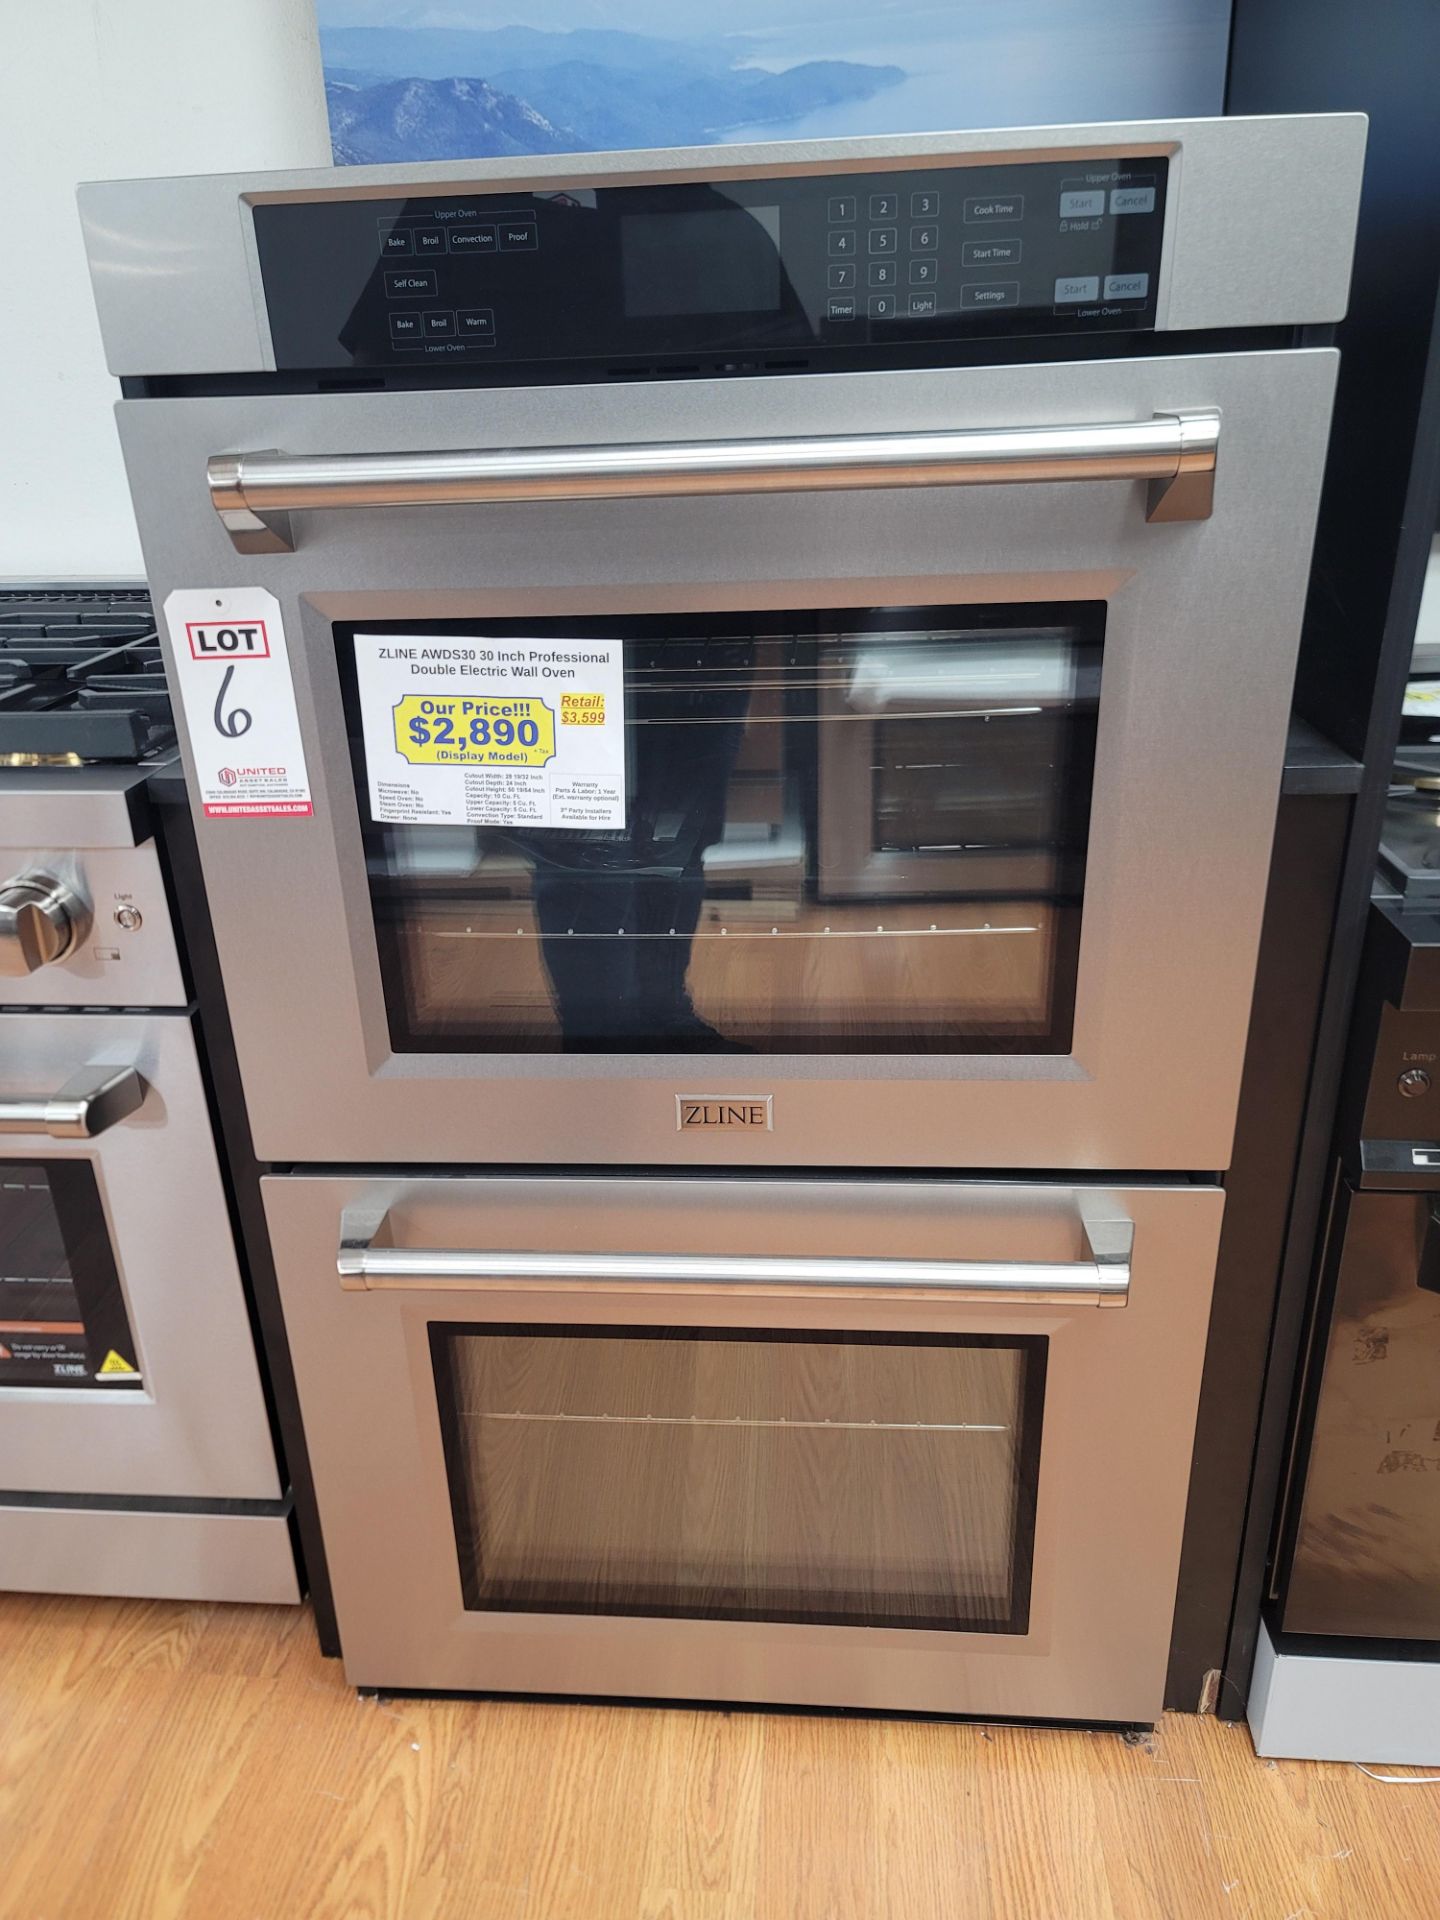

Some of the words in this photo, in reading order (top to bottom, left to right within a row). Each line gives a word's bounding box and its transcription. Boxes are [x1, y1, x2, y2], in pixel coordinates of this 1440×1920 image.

[1086, 174, 1110, 184] Upper
[1111, 173, 1132, 181] Oven
[922, 198, 929, 212] 3
[1070, 198, 1092, 208] Start
[1115, 195, 1148, 206] Cancel
[840, 204, 845, 217] 1
[880, 201, 887, 214] 2
[974, 204, 994, 214] Cook
[995, 204, 1014, 214] Time
[434, 210, 456, 220] Upper
[458, 209, 477, 217] Oven
[1070, 222, 1089, 231] Hold
[388, 238, 405, 246] Bake
[422, 236, 439, 245] Broil
[452, 234, 493, 244] Convection
[508, 232, 528, 241] Proof
[880, 234, 887, 247] 5
[921, 232, 928, 244] 6
[838, 237, 846, 249] 4
[973, 248, 992, 258] Start
[992, 248, 1011, 257] Time
[838, 271, 846, 283] 7
[879, 269, 886, 281] 8
[920, 266, 927, 279] 9
[394, 279, 407, 288] Self
[408, 279, 428, 287] Clean
[1109, 281, 1141, 292] Cancel
[1064, 284, 1087, 295] Start
[975, 290, 1005, 302] Settings
[831, 305, 853, 314] Timer
[878, 301, 885, 313] 0
[912, 300, 933, 311] Light
[1078, 308, 1100, 317] Lower
[1102, 308, 1122, 316] Oven
[397, 320, 413, 328] Bake
[431, 319, 447, 327] Broil
[466, 318, 487, 326] Warm
[425, 344, 446, 352] Lower
[447, 344, 466, 352] Oven
[197, 629, 257, 652] LOT
[378, 648, 418, 659] ZLINE
[421, 649, 476, 660] AWDS30
[480, 650, 494, 661] 30
[498, 650, 525, 662] Inch
[529, 651, 609, 663] Professional
[411, 664, 456, 675] Double
[460, 664, 507, 677] Electric
[511, 666, 538, 677] Wall
[542, 667, 575, 678] Oven
[214, 665, 252, 738] 6
[561, 695, 605, 708] Retail:
[420, 700, 455, 715] Our
[462, 701, 531, 717] Price!!!
[561, 711, 605, 724] $3,599
[409, 716, 539, 750] $2,890
[436, 750, 484, 762] (Display
[488, 752, 528, 763] Model)
[237, 767, 286, 775] UNITED
[1403, 1051, 1437, 1062] Lamp
[685, 1106, 763, 1124] ZLINE
